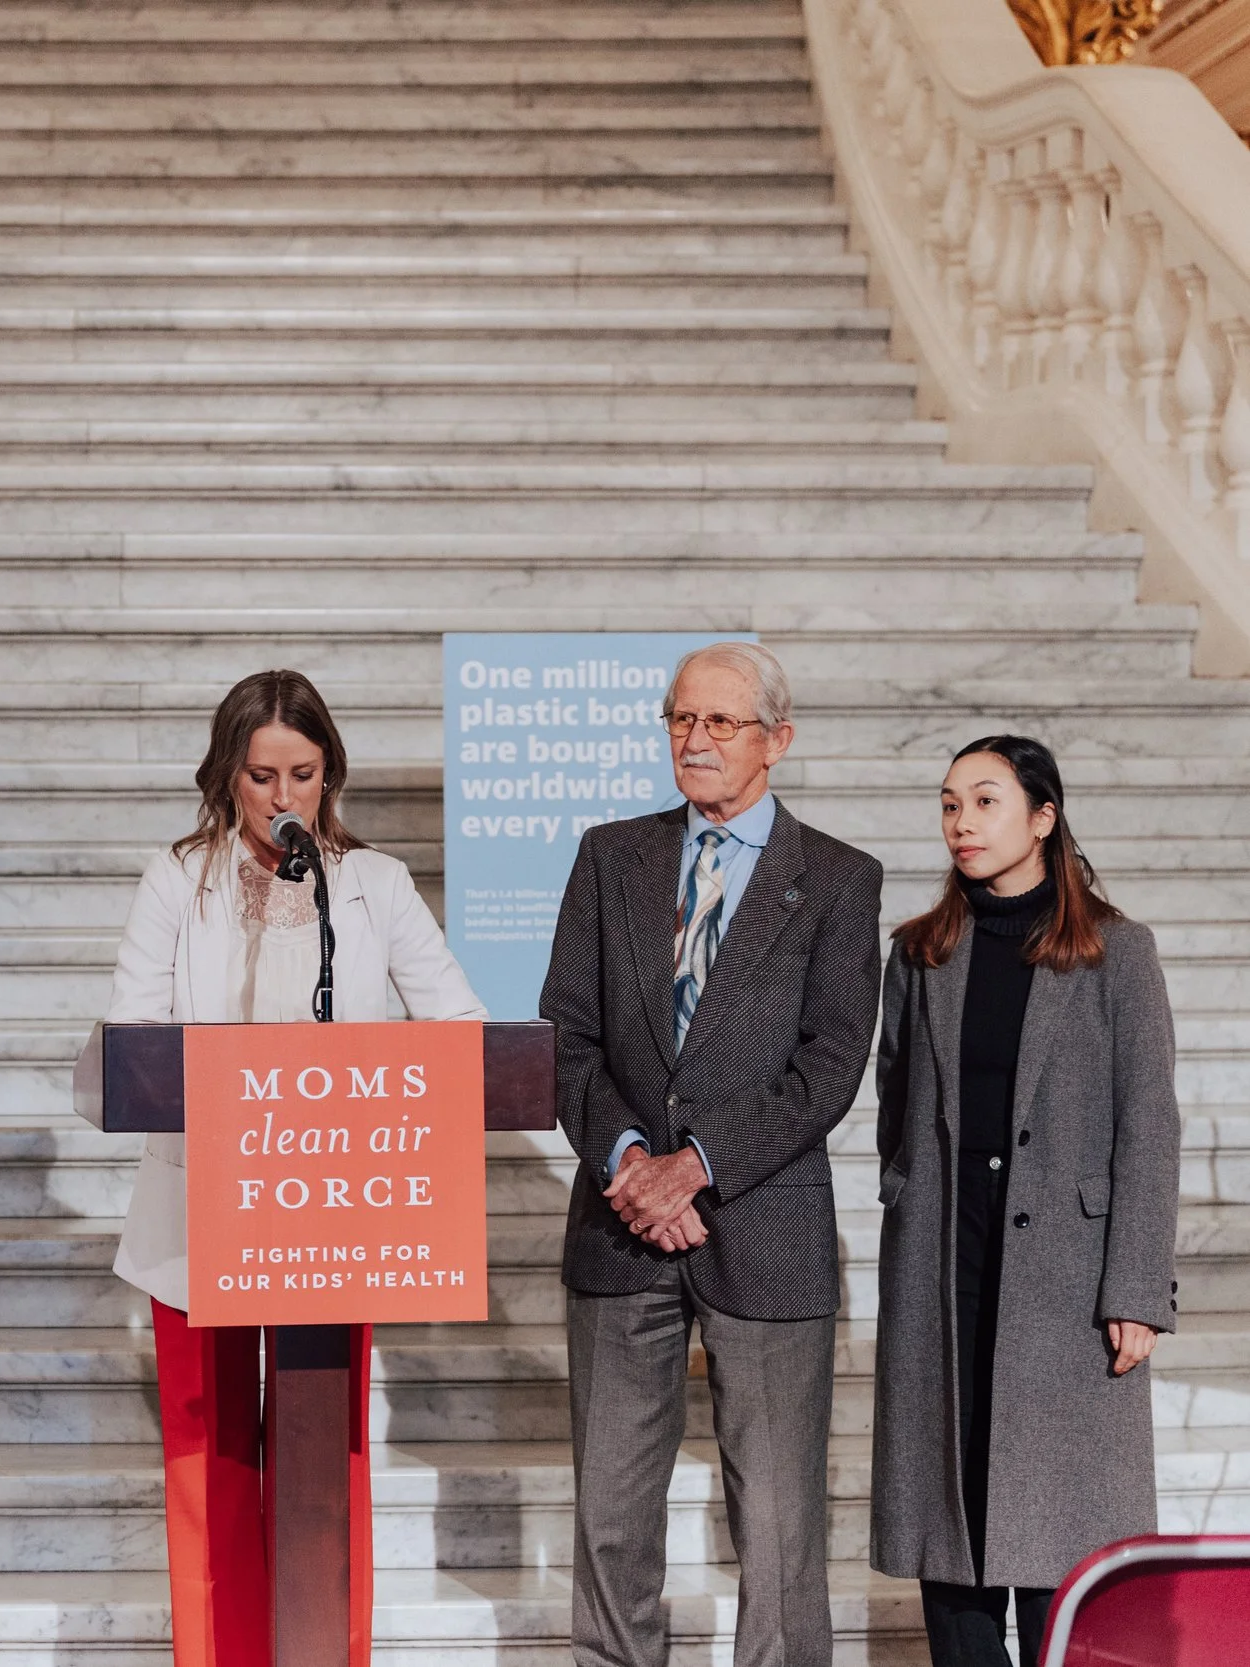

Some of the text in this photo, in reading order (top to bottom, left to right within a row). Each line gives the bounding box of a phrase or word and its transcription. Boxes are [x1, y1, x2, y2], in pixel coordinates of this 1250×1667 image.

[460, 660, 667, 690] One million
[460, 697, 664, 732] plastic bott
[460, 734, 661, 769] are bought
[461, 771, 654, 801] worldwide
[461, 814, 561, 844] every
[239, 1064, 428, 1101] MOMS
[239, 1112, 431, 1156] clean air
[237, 1176, 433, 1210] FORCE
[241, 1244, 431, 1264] FIGHTING FOR
[218, 1270, 466, 1291] OUR KIDS’ HEALTH
